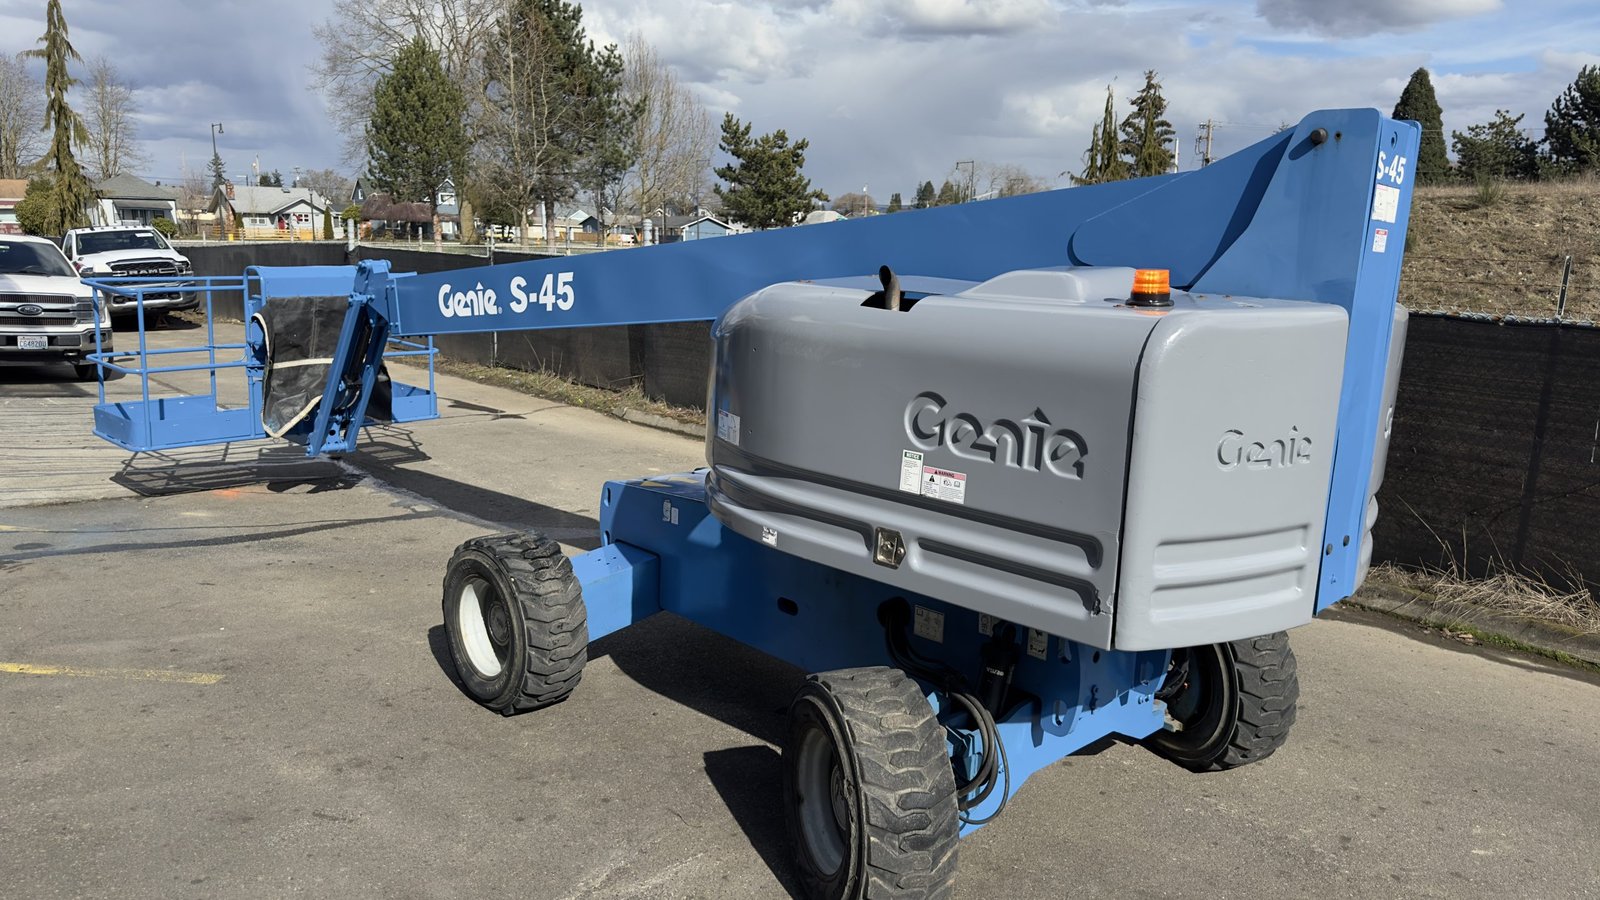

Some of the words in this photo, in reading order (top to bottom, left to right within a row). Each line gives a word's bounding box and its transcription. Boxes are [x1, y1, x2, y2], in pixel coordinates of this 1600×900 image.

[1376, 150, 1407, 185] S-45
[438, 281, 498, 318] Genie
[509, 271, 575, 313] S-45
[903, 391, 1089, 480] Genie
[1216, 425, 1312, 472] Genie
[938, 470, 955, 478] WARNING
